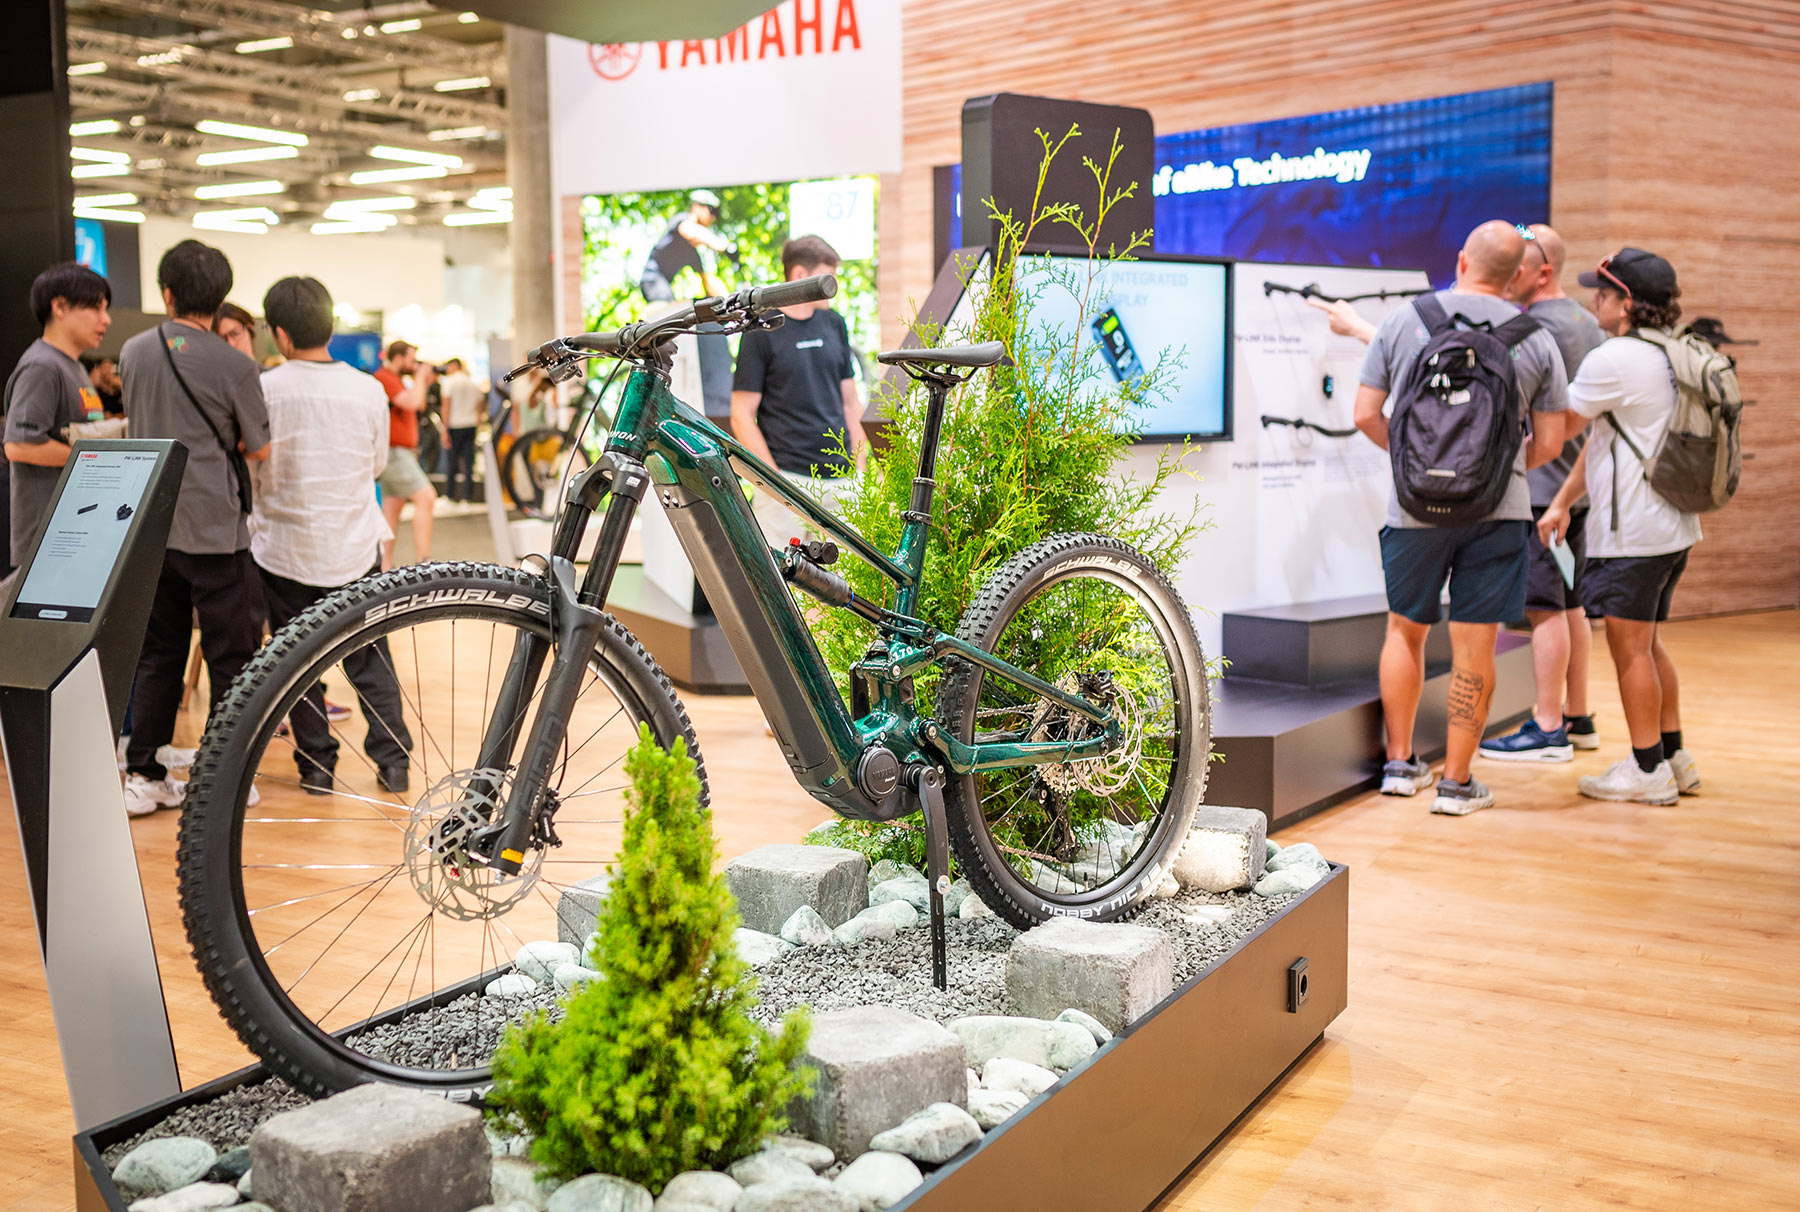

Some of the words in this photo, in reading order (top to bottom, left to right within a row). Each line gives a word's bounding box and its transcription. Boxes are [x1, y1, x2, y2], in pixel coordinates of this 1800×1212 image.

[1233, 146, 1372, 188] Technology
[825, 191, 859, 220] 87
[1042, 555, 1142, 580] SCHWALBE
[364, 588, 550, 625] SCHWALBE
